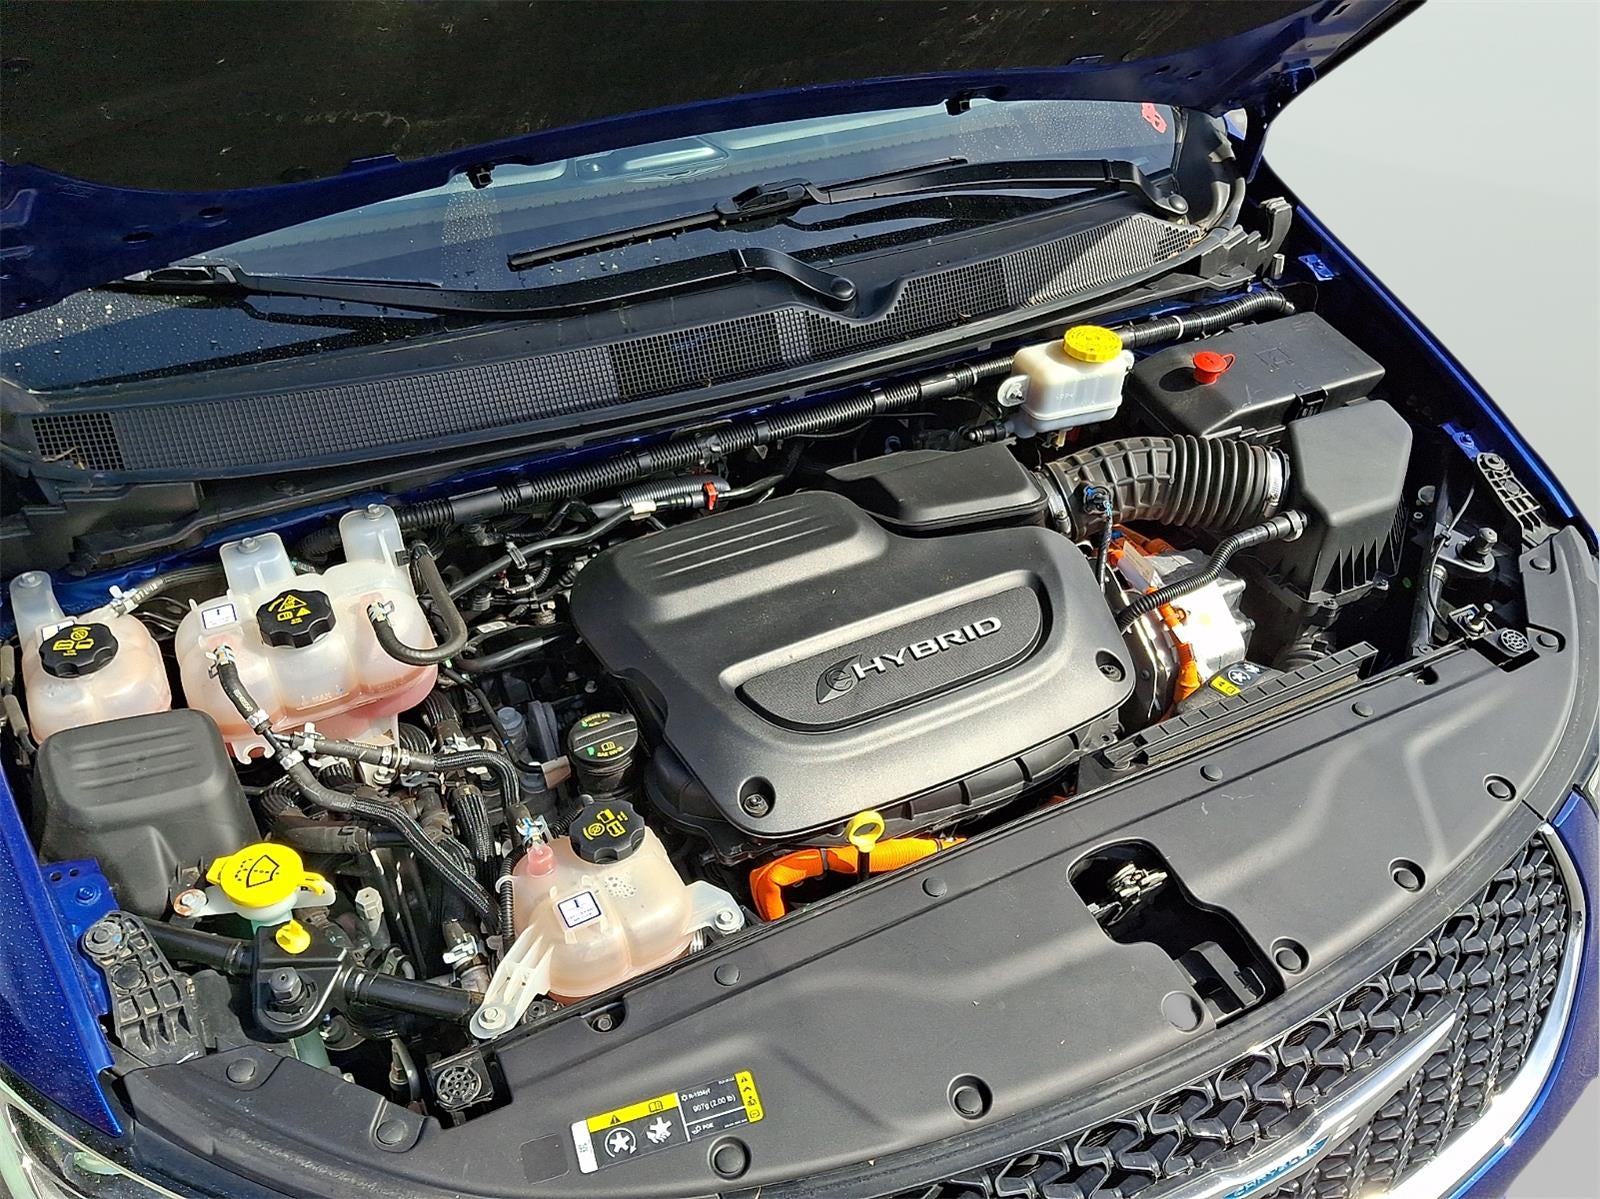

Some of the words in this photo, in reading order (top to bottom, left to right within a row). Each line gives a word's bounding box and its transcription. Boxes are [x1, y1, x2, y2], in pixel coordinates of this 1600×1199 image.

[851, 616, 1002, 682] HYBRID
[692, 1102, 710, 1113] 907g
[709, 1096, 727, 1109] (2.00
